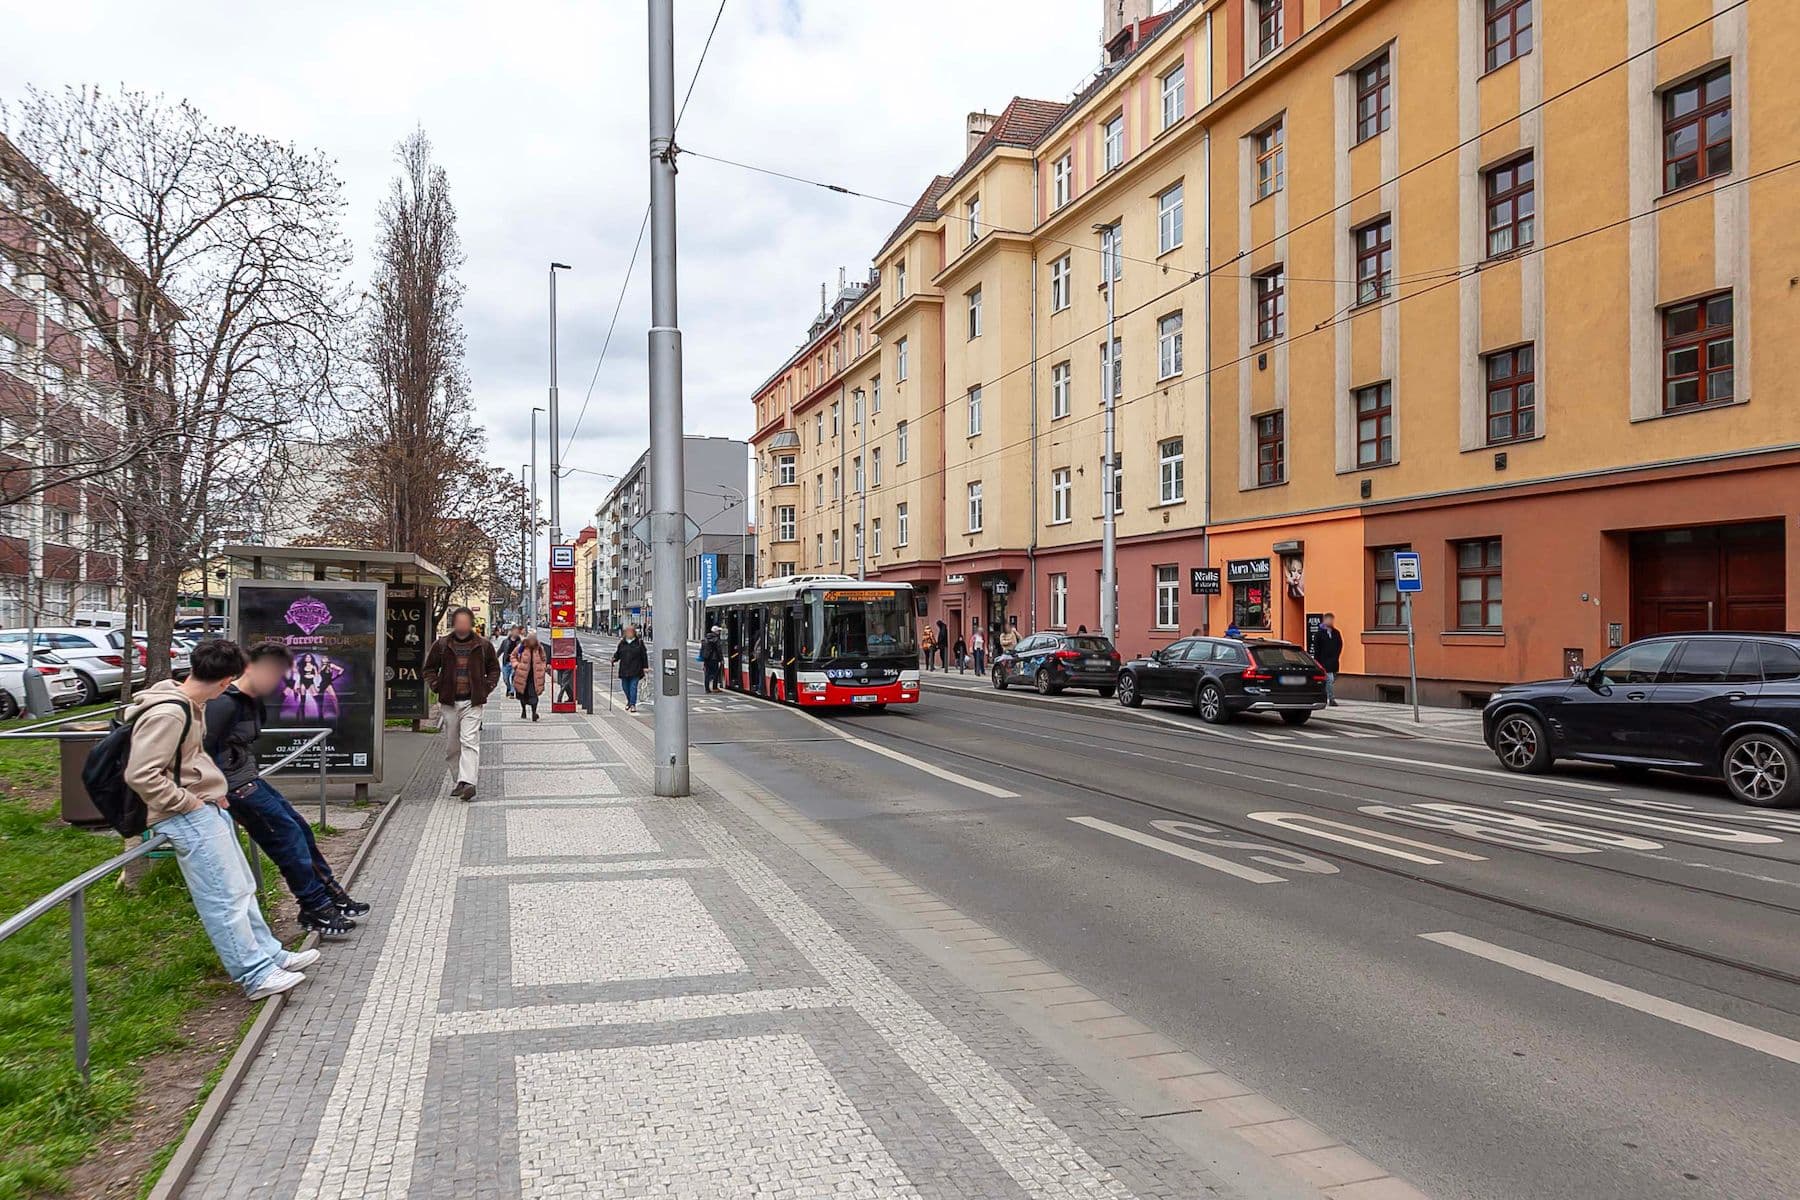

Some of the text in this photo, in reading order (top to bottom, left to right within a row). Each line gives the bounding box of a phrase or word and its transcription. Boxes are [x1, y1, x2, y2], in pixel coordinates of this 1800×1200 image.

[1230, 560, 1269, 575] Aura Nails
[1194, 571, 1219, 582] Nails
[285, 634, 325, 646] Forever
